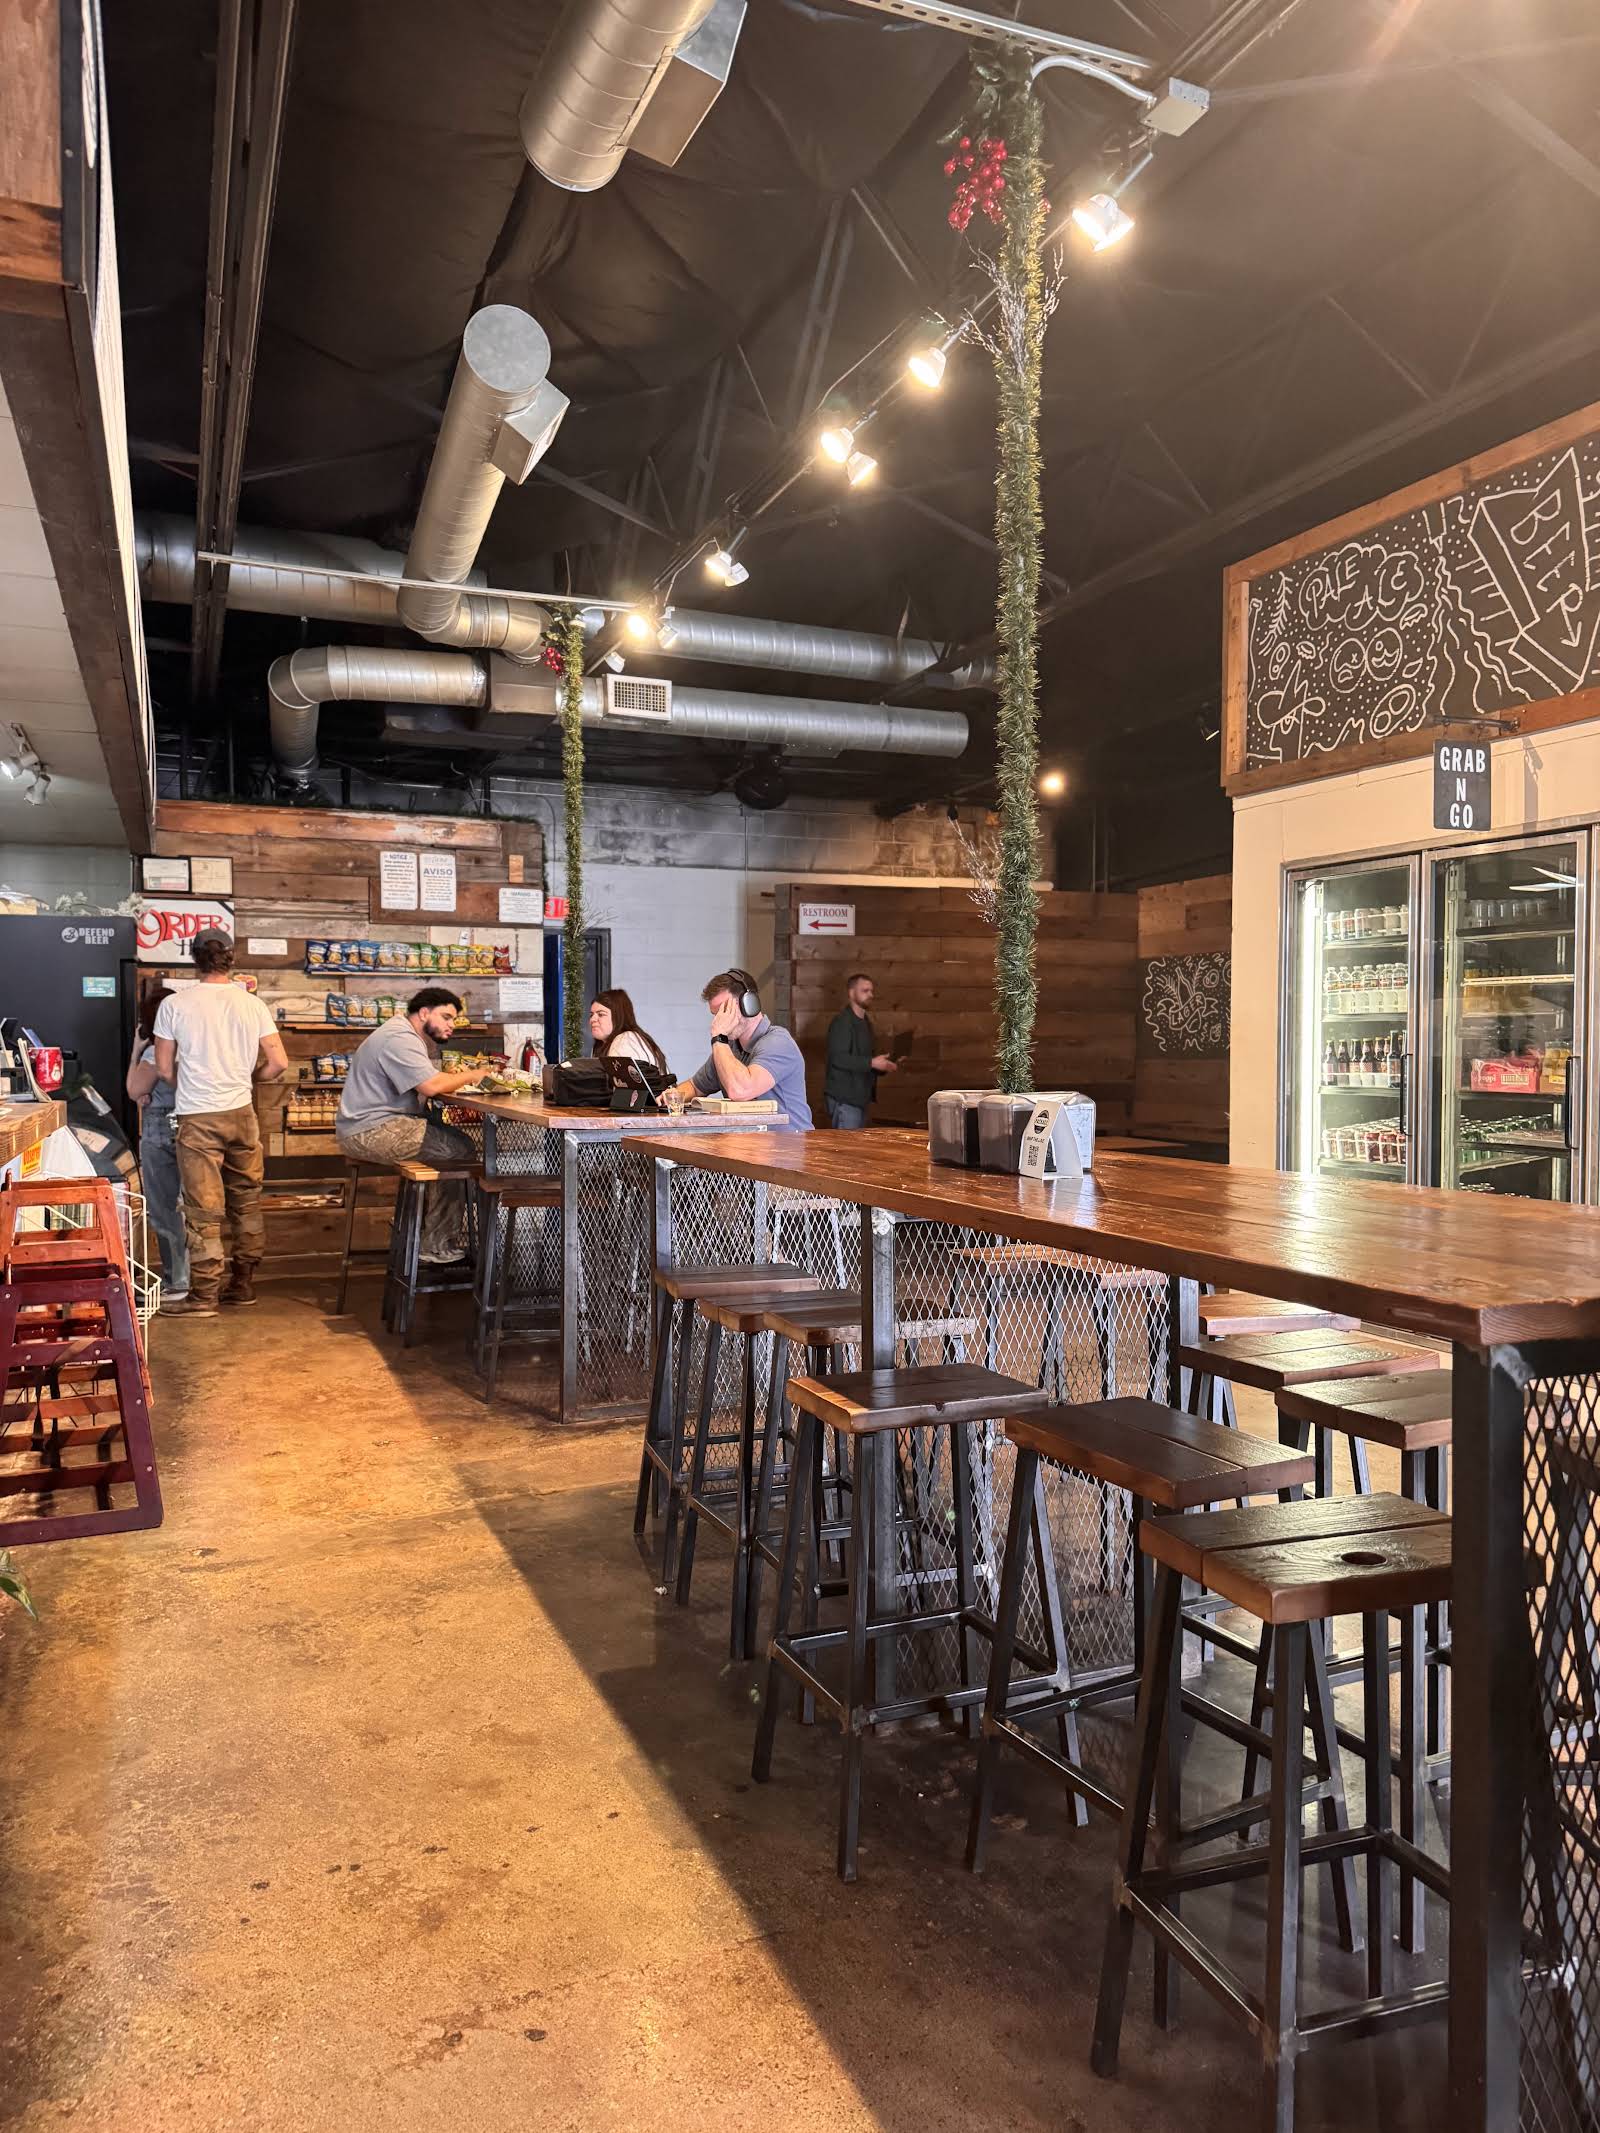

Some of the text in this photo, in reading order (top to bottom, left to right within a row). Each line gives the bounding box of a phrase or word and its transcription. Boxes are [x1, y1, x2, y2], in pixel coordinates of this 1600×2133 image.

[1510, 488, 1584, 632] BEER
[1305, 552, 1360, 619] PALE
[1440, 746, 1486, 773] GRAB
[1456, 777, 1467, 802] N
[1449, 802, 1474, 829] GO
[423, 867, 453, 876] AVISO
[803, 907, 848, 918] RESTROOM
[78, 927, 115, 937] DEFEND
[84, 936, 110, 945] BEER
[136, 908, 231, 950] ORDER
[1172, 995, 1204, 1026] LAGER
